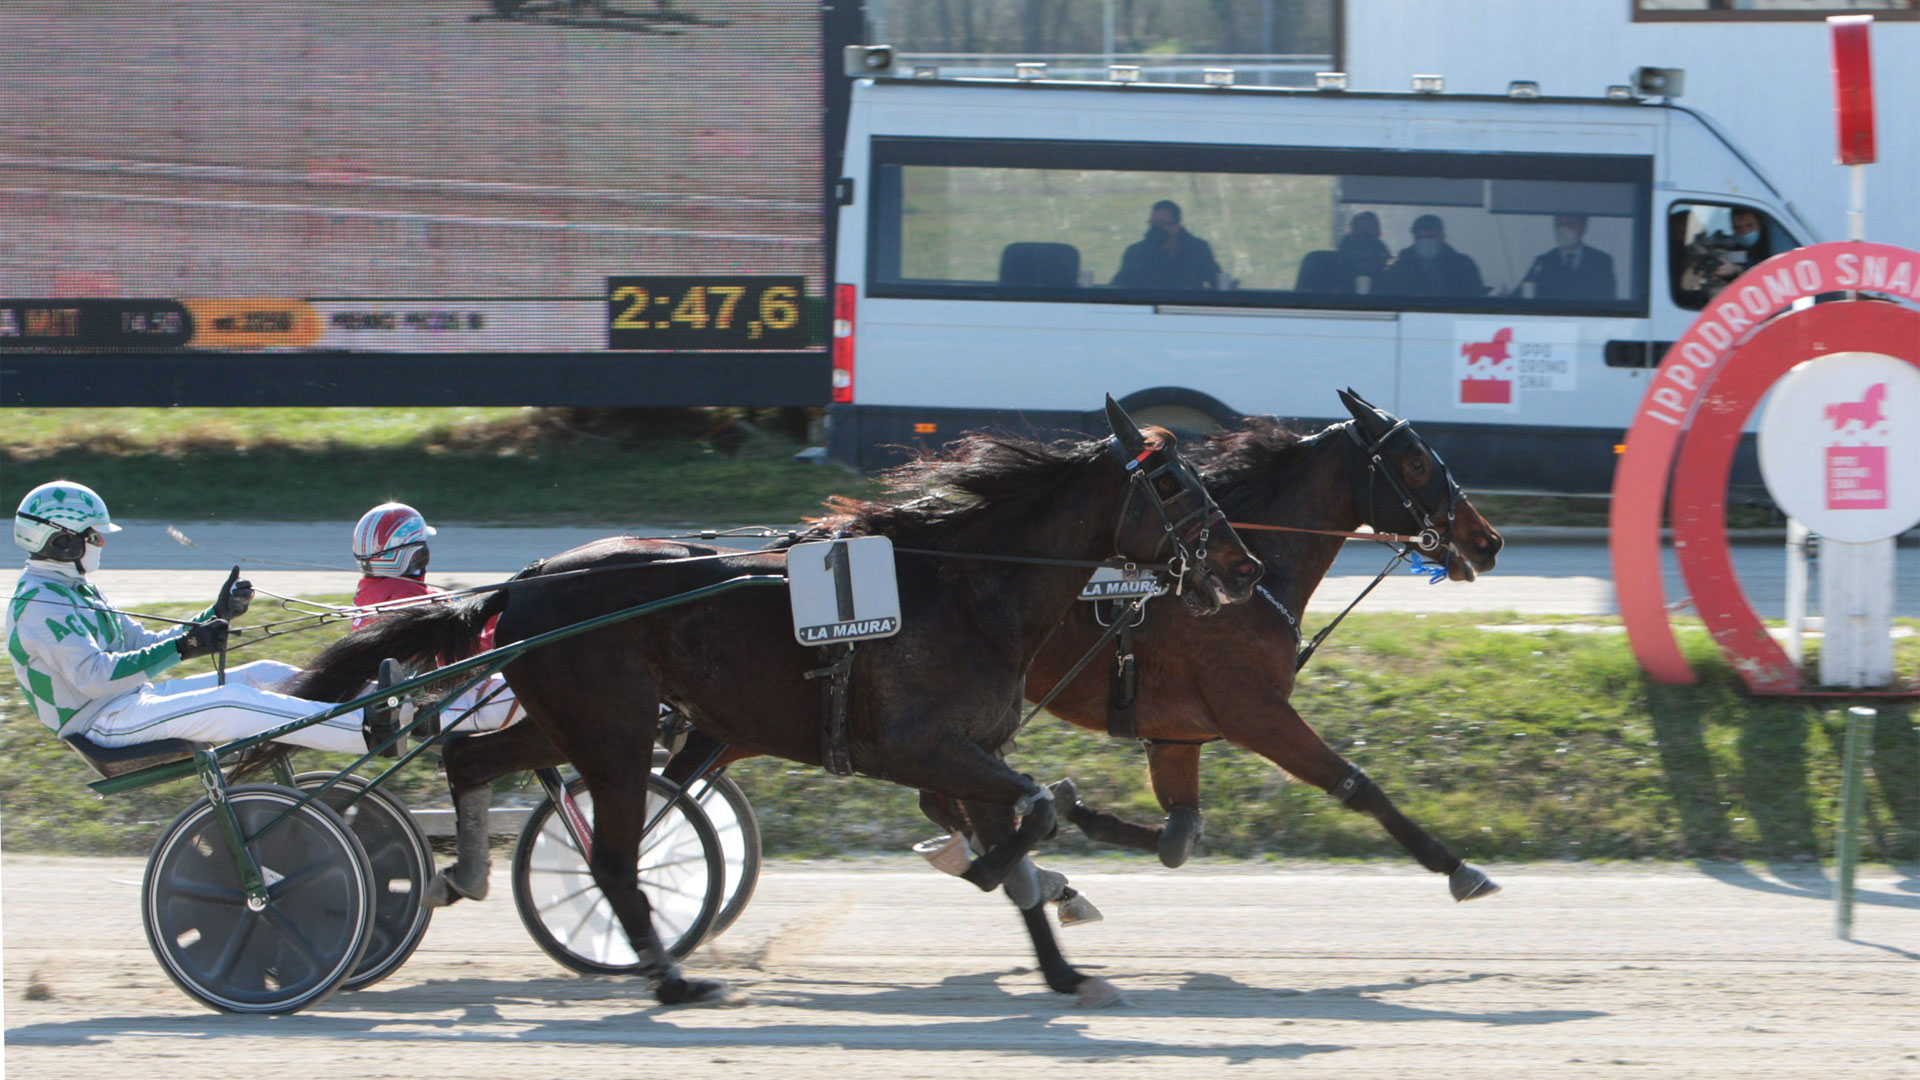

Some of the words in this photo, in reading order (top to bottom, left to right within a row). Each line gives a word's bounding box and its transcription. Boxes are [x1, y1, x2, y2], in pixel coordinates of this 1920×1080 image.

[610, 286, 800, 339] 2:47,6
[1646, 260, 1823, 425] IPPODROMO
[824, 541, 855, 621] 1
[1082, 583, 1102, 596] LA
[807, 627, 828, 640] LA
[833, 619, 891, 638] MAURA
